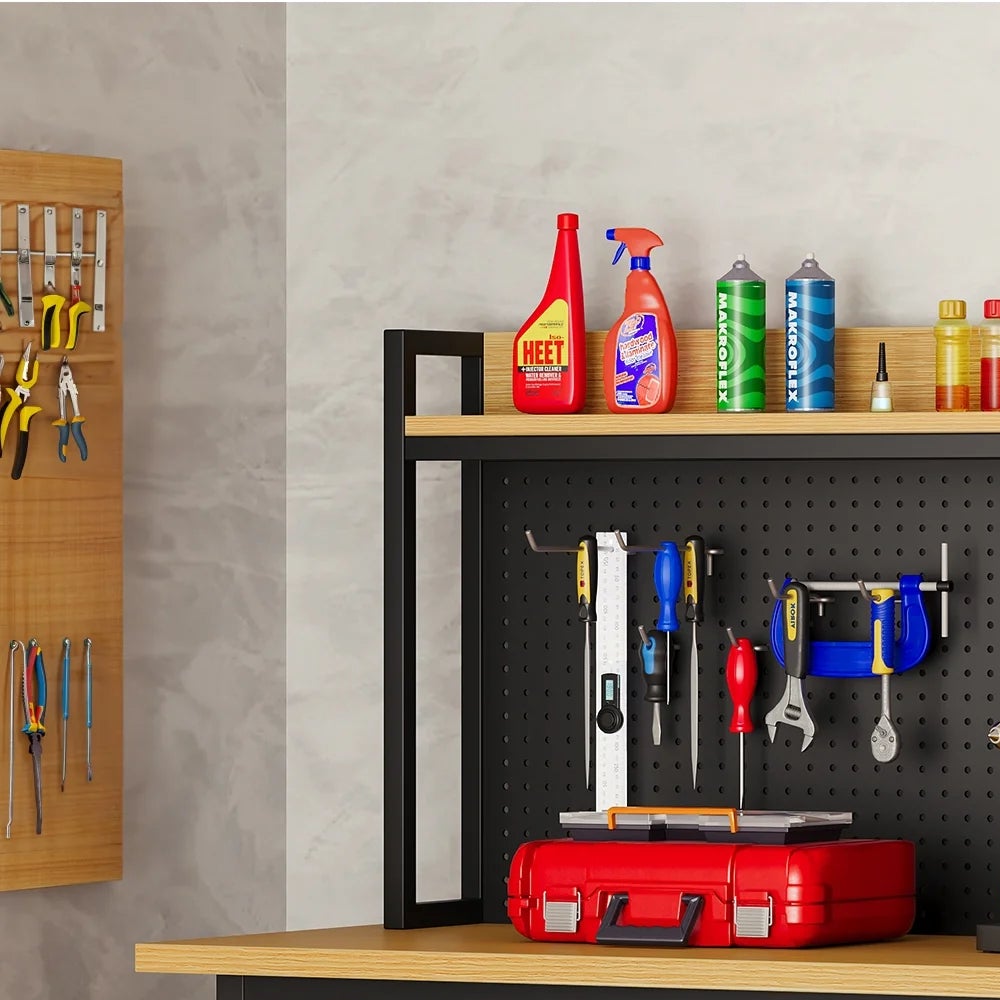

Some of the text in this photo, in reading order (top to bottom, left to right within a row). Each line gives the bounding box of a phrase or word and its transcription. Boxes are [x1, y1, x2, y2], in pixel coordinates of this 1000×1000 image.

[523, 341, 564, 364] HEET
[718, 292, 728, 403] MAKROFLEX
[788, 291, 798, 403] MAKROFLEX
